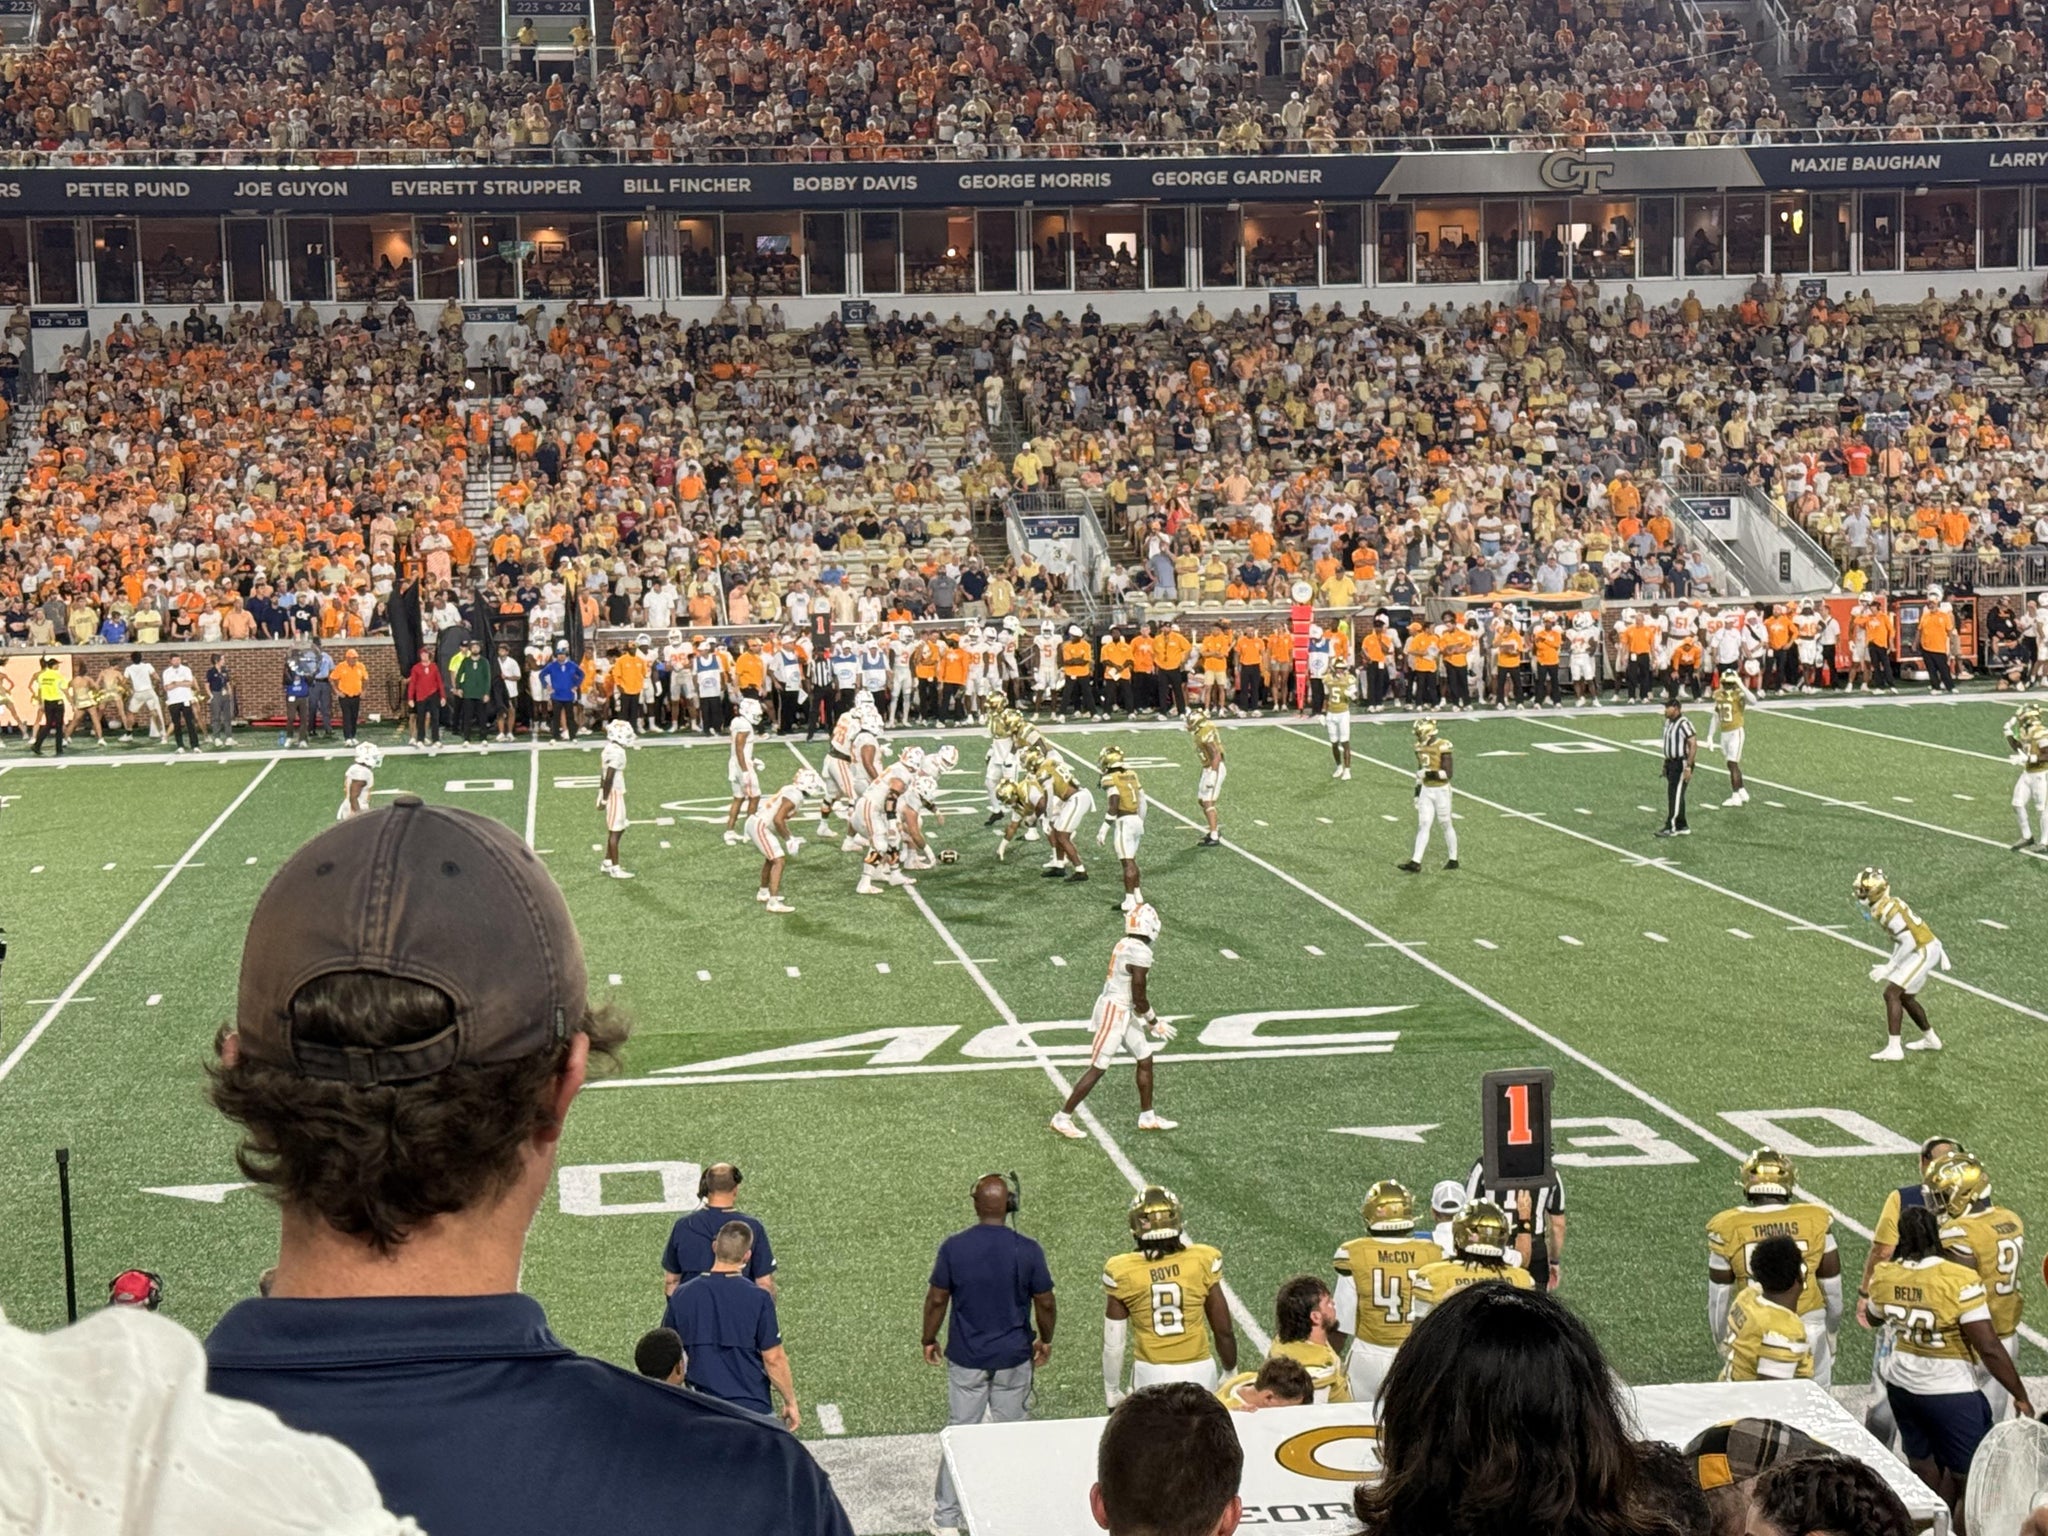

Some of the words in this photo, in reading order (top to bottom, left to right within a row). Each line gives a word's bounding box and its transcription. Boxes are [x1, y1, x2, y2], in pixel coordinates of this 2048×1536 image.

[517, 2, 539, 12] 223
[560, 2, 581, 12] 224
[1790, 157, 1848, 172] MAXIE
[1852, 154, 1941, 171] BAUGHAN
[1989, 152, 2048, 167] LARRY
[1152, 171, 1228, 186] GEORGE
[1233, 169, 1322, 185] GARDNER
[1540, 149, 1615, 195] GT
[234, 182, 273, 196] JOE
[277, 181, 348, 196] GUYON
[391, 181, 478, 196] EVERETT
[483, 179, 581, 195] STRUPPER
[624, 178, 665, 193] BILL
[669, 178, 751, 193] FINCHER
[793, 176, 858, 191] BOBBY
[863, 175, 918, 190] DAVIS
[958, 174, 1036, 189] GEORGE
[1040, 173, 1112, 188] MORRIS
[66, 182, 129, 197] PETER
[134, 182, 190, 197] PUND
[1708, 506, 1726, 516] CL3
[816, 616, 825, 634] 1
[1331, 687, 1341, 703] 5
[650, 1005, 1421, 1075] ACC
[1505, 1085, 1532, 1145] 1
[1752, 1221, 1799, 1238] THOMAS
[1378, 1250, 1416, 1264] McCOY
[1149, 1263, 1181, 1282] BOYD
[1151, 1282, 1185, 1337] 8
